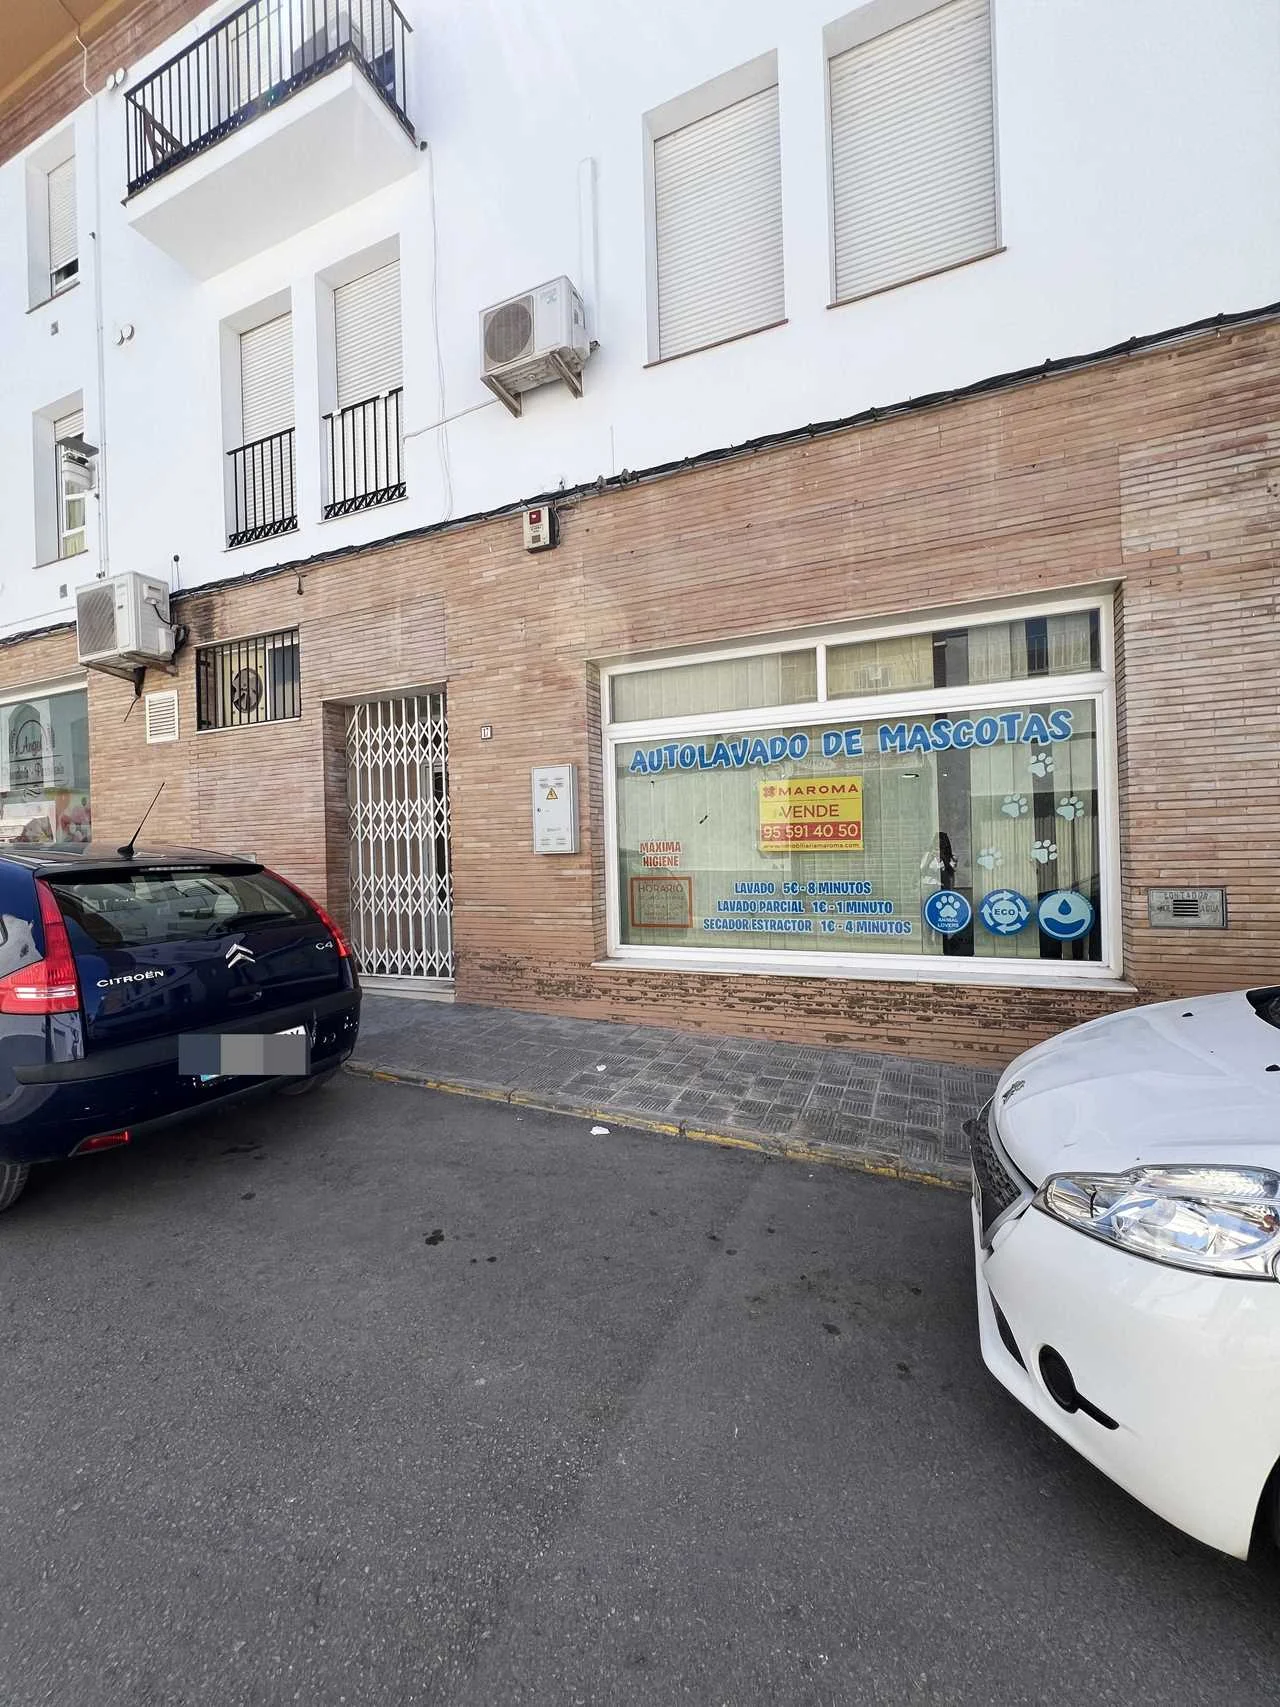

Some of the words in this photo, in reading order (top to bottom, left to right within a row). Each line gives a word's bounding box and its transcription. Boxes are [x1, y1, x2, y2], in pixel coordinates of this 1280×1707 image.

[629, 733, 809, 774] AUTOLAVADO
[822, 728, 864, 758] DE
[879, 709, 1072, 754] MASCOTAS
[778, 783, 859, 796] MAROMA
[780, 803, 840, 819] VENDE
[763, 825, 781, 839] 95
[785, 824, 808, 838] 591
[812, 824, 834, 838] 40
[838, 823, 858, 837] 50
[642, 855, 679, 867] HIGIENE
[639, 884, 684, 893] HORARIO
[735, 882, 775, 894] LAVADO
[783, 882, 799, 894] 5€
[808, 882, 815, 894] 8
[819, 882, 871, 894] MINUTOS
[1164, 891, 1209, 900] CONTADOR
[717, 900, 757, 912] LAVADO
[759, 900, 804, 913] PARCIAL
[812, 901, 827, 913] 1€
[837, 901, 843, 913] 1
[846, 901, 893, 914] MINUTO
[995, 908, 1015, 917] ECO
[704, 919, 749, 930] SECADOR
[752, 919, 812, 931] ESTRACTOR
[821, 920, 835, 932] 1€
[845, 920, 853, 932] 4
[856, 920, 911, 934] MINUTOS
[315, 940, 334, 951] C4
[96, 970, 165, 989] CITROËN
